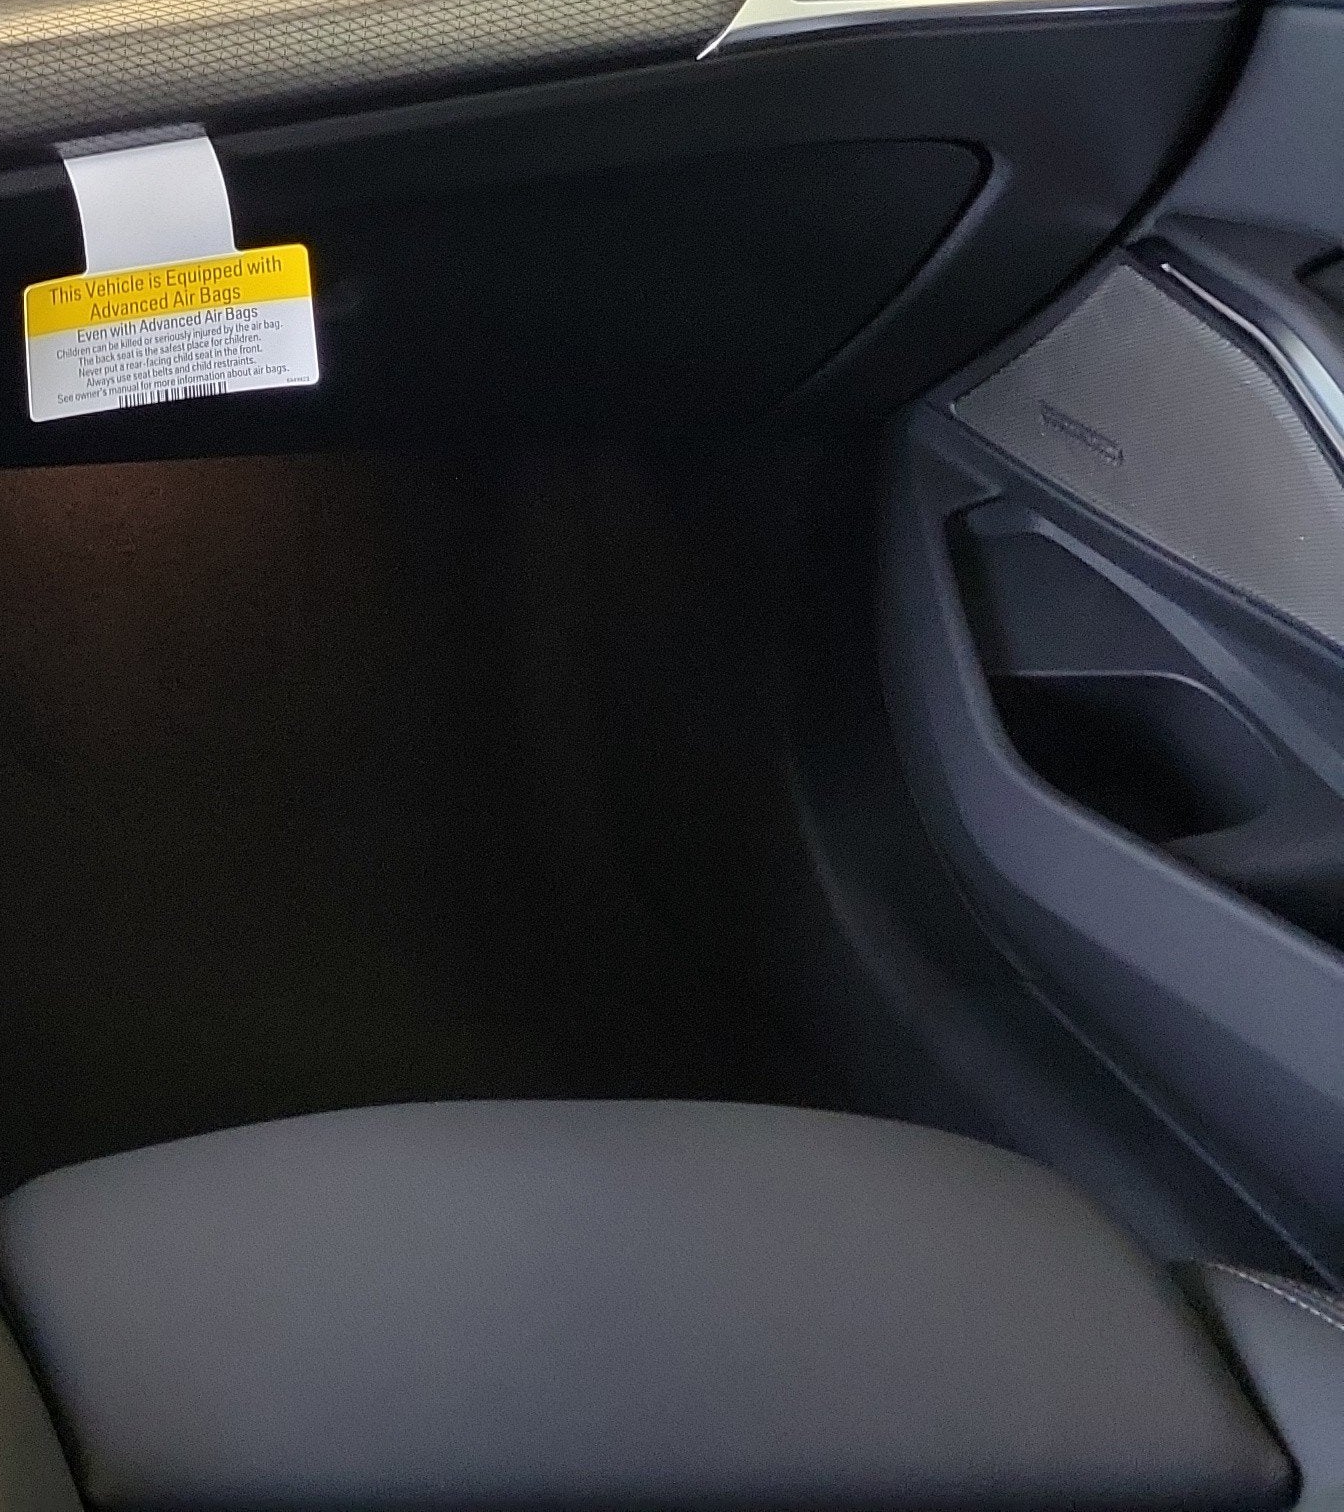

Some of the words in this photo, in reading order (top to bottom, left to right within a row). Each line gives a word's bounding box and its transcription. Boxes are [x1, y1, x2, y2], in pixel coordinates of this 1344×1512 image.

[50, 285, 82, 306] This
[85, 275, 144, 299] Vehicle
[148, 272, 162, 289] is
[166, 259, 243, 287] Equipped
[247, 254, 282, 276] with
[90, 292, 169, 321] Advanced
[173, 290, 196, 309] Air
[200, 286, 241, 305] Bags
[56, 345, 91, 361] Children
[92, 344, 107, 356] can
[109, 340, 119, 351] be
[120, 337, 143, 350] killed
[144, 337, 153, 347] or
[154, 330, 191, 344] seriously
[193, 325, 222, 340] injured
[223, 324, 234, 336] by
[236, 321, 250, 333] the
[251, 320, 262, 332] air
[264, 319, 284, 331] bag.
[77, 328, 108, 343] Even
[110, 322, 137, 338] with
[139, 311, 202, 334] Advanced
[204, 309, 223, 325] Air
[225, 306, 258, 322] Bags
[78, 366, 102, 378] Never
[104, 363, 118, 374] put
[126, 355, 172, 371] rear-facing
[173, 351, 194, 364] child
[195, 349, 213, 361] seat
[214, 347, 222, 358] in
[223, 345, 238, 357] the
[239, 343, 262, 355] front.
[79, 356, 94, 367] The
[95, 352, 115, 365] back
[117, 350, 135, 360] seat
[136, 347, 144, 358] is
[145, 345, 158, 356] the
[159, 341, 185, 355] safest
[187, 338, 209, 353] place
[211, 336, 222, 348] for
[224, 333, 262, 346] children.
[57, 393, 74, 404] See
[75, 387, 108, 402] owner's
[109, 382, 139, 396] manual
[140, 380, 152, 391] for
[153, 377, 176, 389] more
[177, 370, 226, 385] information
[227, 366, 252, 380] about
[253, 365, 264, 376] air
[265, 363, 290, 376] bags.
[86, 375, 115, 388] Always
[116, 373, 131, 384] use
[133, 369, 151, 381] seat
[152, 366, 173, 379] belts
[174, 363, 191, 375] and
[192, 360, 212, 373] child
[214, 356, 257, 370] restraints.
